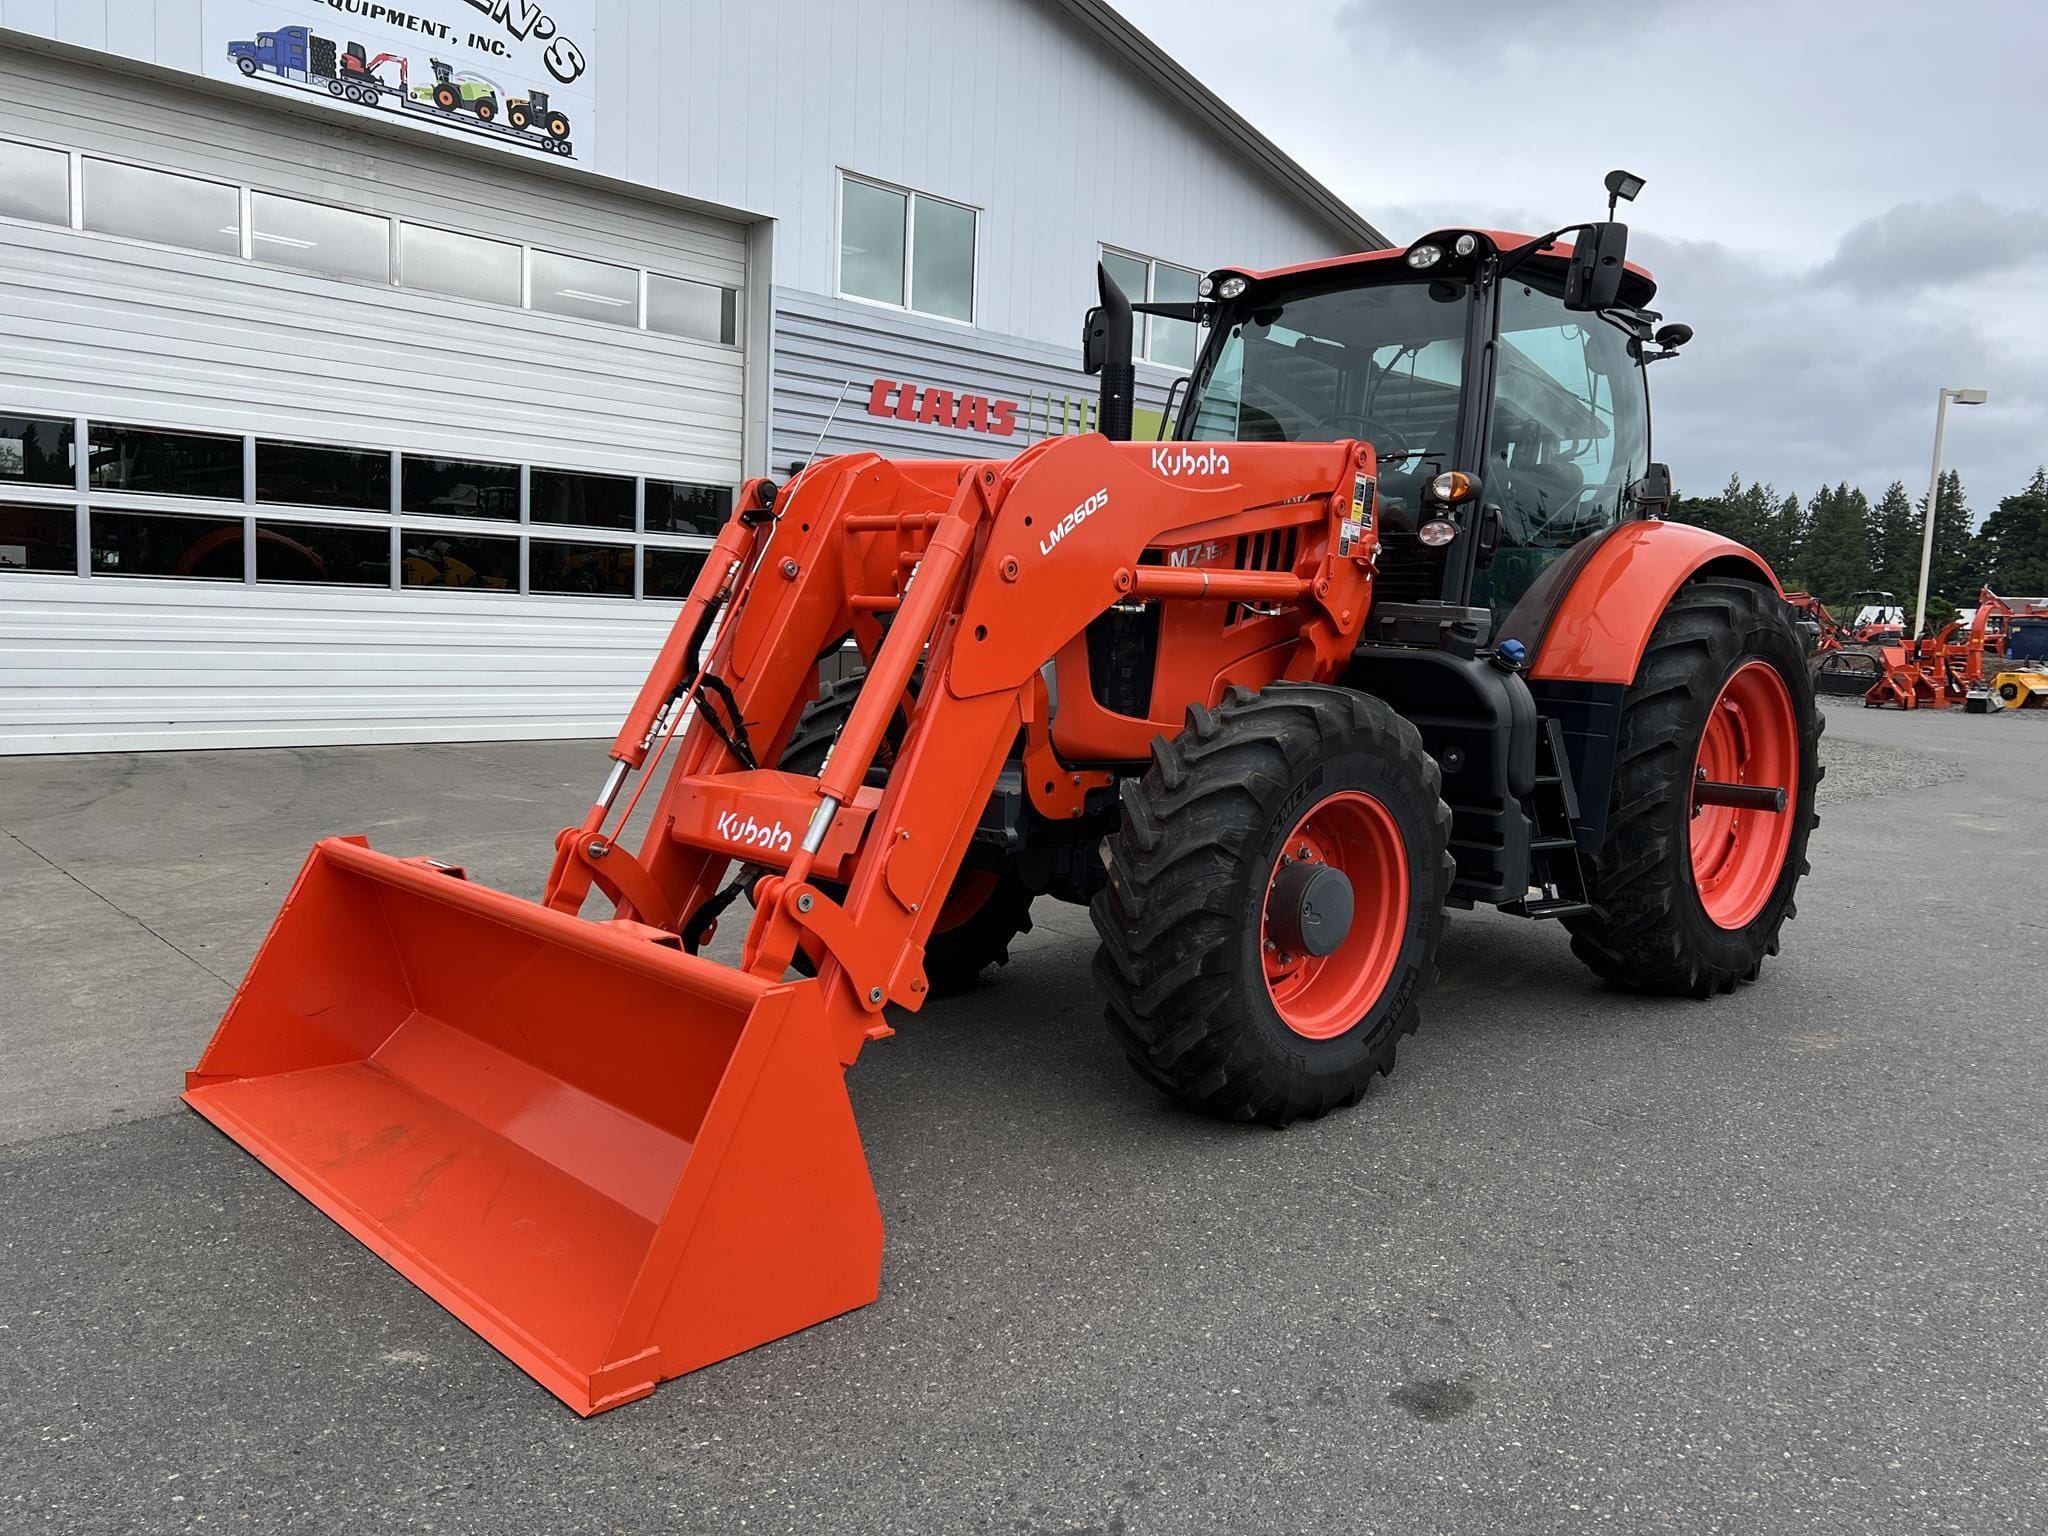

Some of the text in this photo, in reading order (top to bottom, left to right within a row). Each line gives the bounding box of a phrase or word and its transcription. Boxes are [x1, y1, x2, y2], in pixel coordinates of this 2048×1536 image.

[310, 0, 512, 59] QUIPMENT, INC.
[867, 378, 1018, 437] CLAAS
[1152, 447, 1230, 476] Kubota
[1039, 487, 1109, 556] LM2605
[716, 810, 793, 852] Kubota
